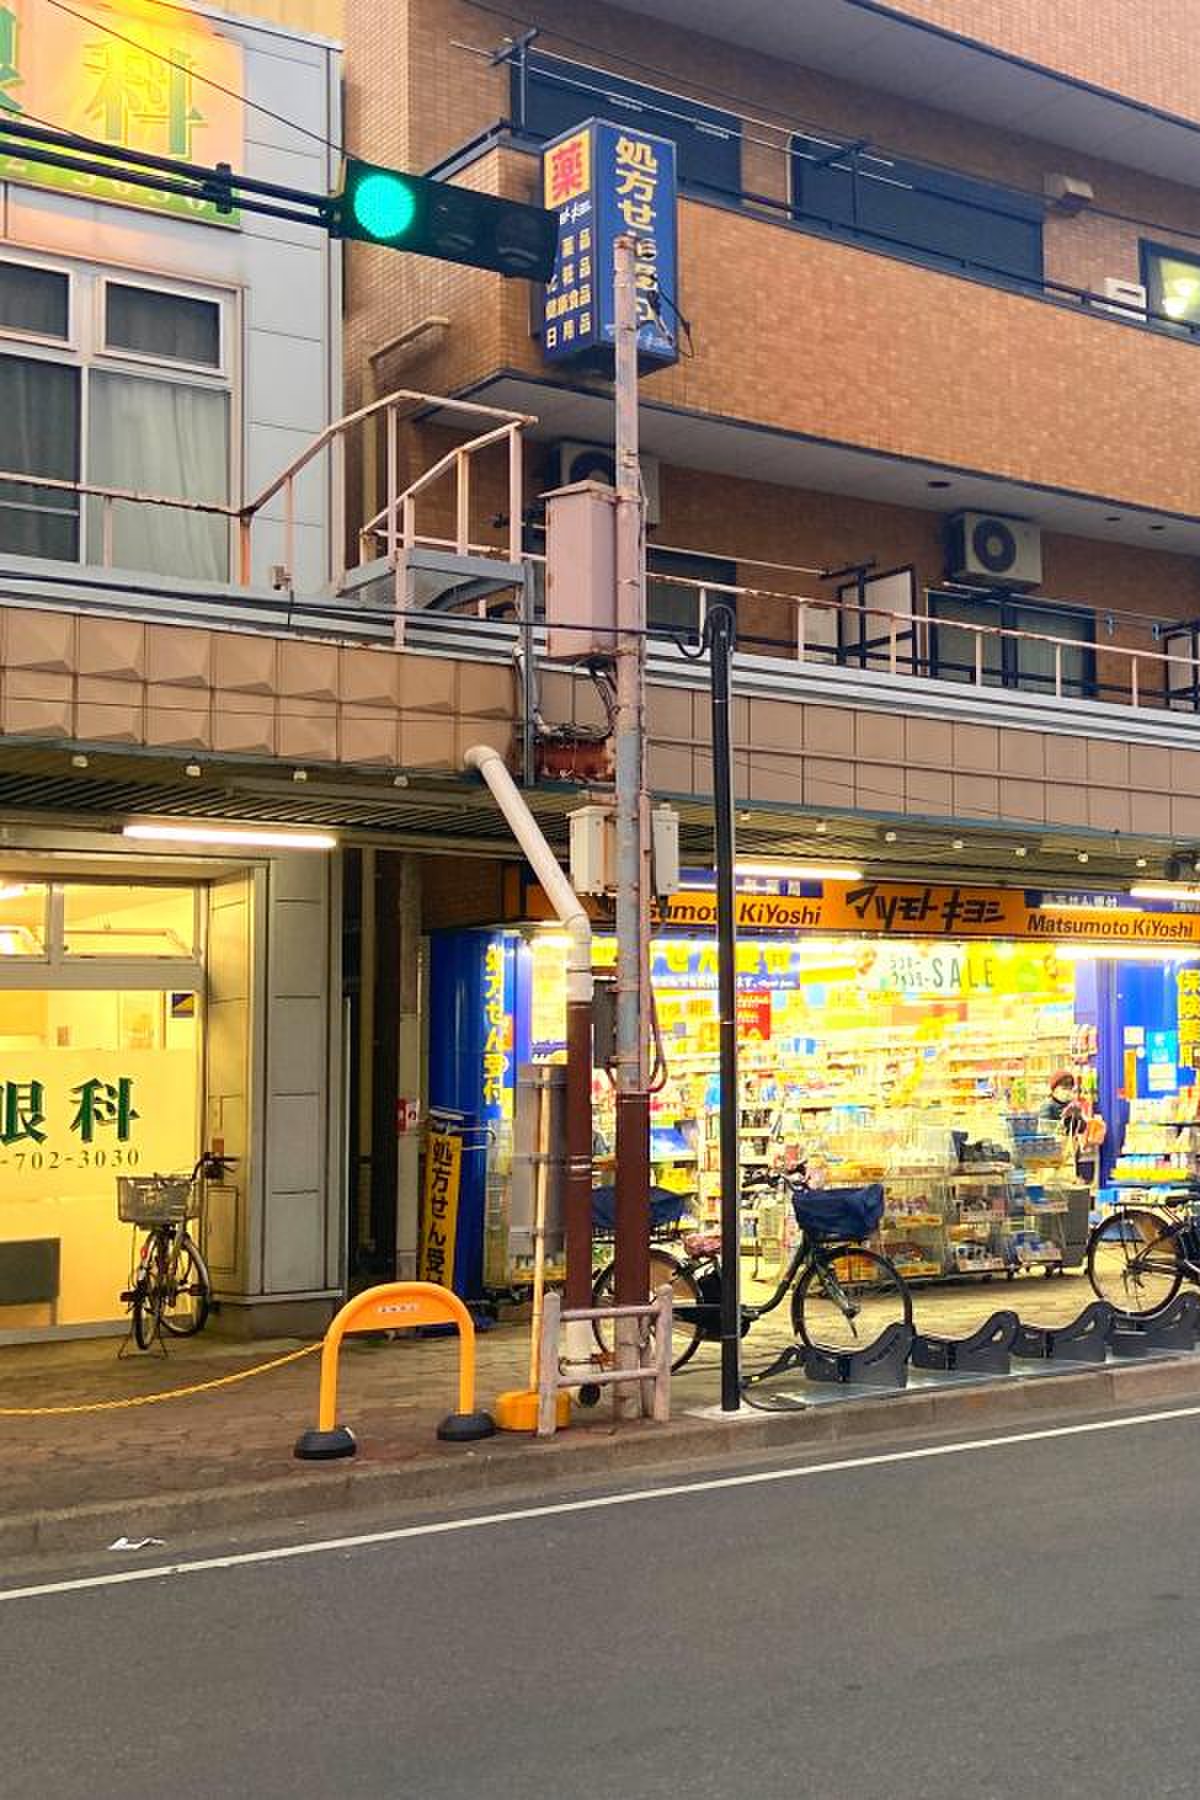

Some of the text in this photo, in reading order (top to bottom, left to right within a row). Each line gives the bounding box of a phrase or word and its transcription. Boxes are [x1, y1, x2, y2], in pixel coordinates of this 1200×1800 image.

[552, 140, 582, 201] 薬
[739, 903, 822, 925] KiYoshi
[846, 885, 1005, 929] マツモトキヨシ
[1027, 914, 1194, 938] Matsumoto KiYoshi
[931, 957, 996, 988] SALE
[0, 1077, 141, 1146] 眼科
